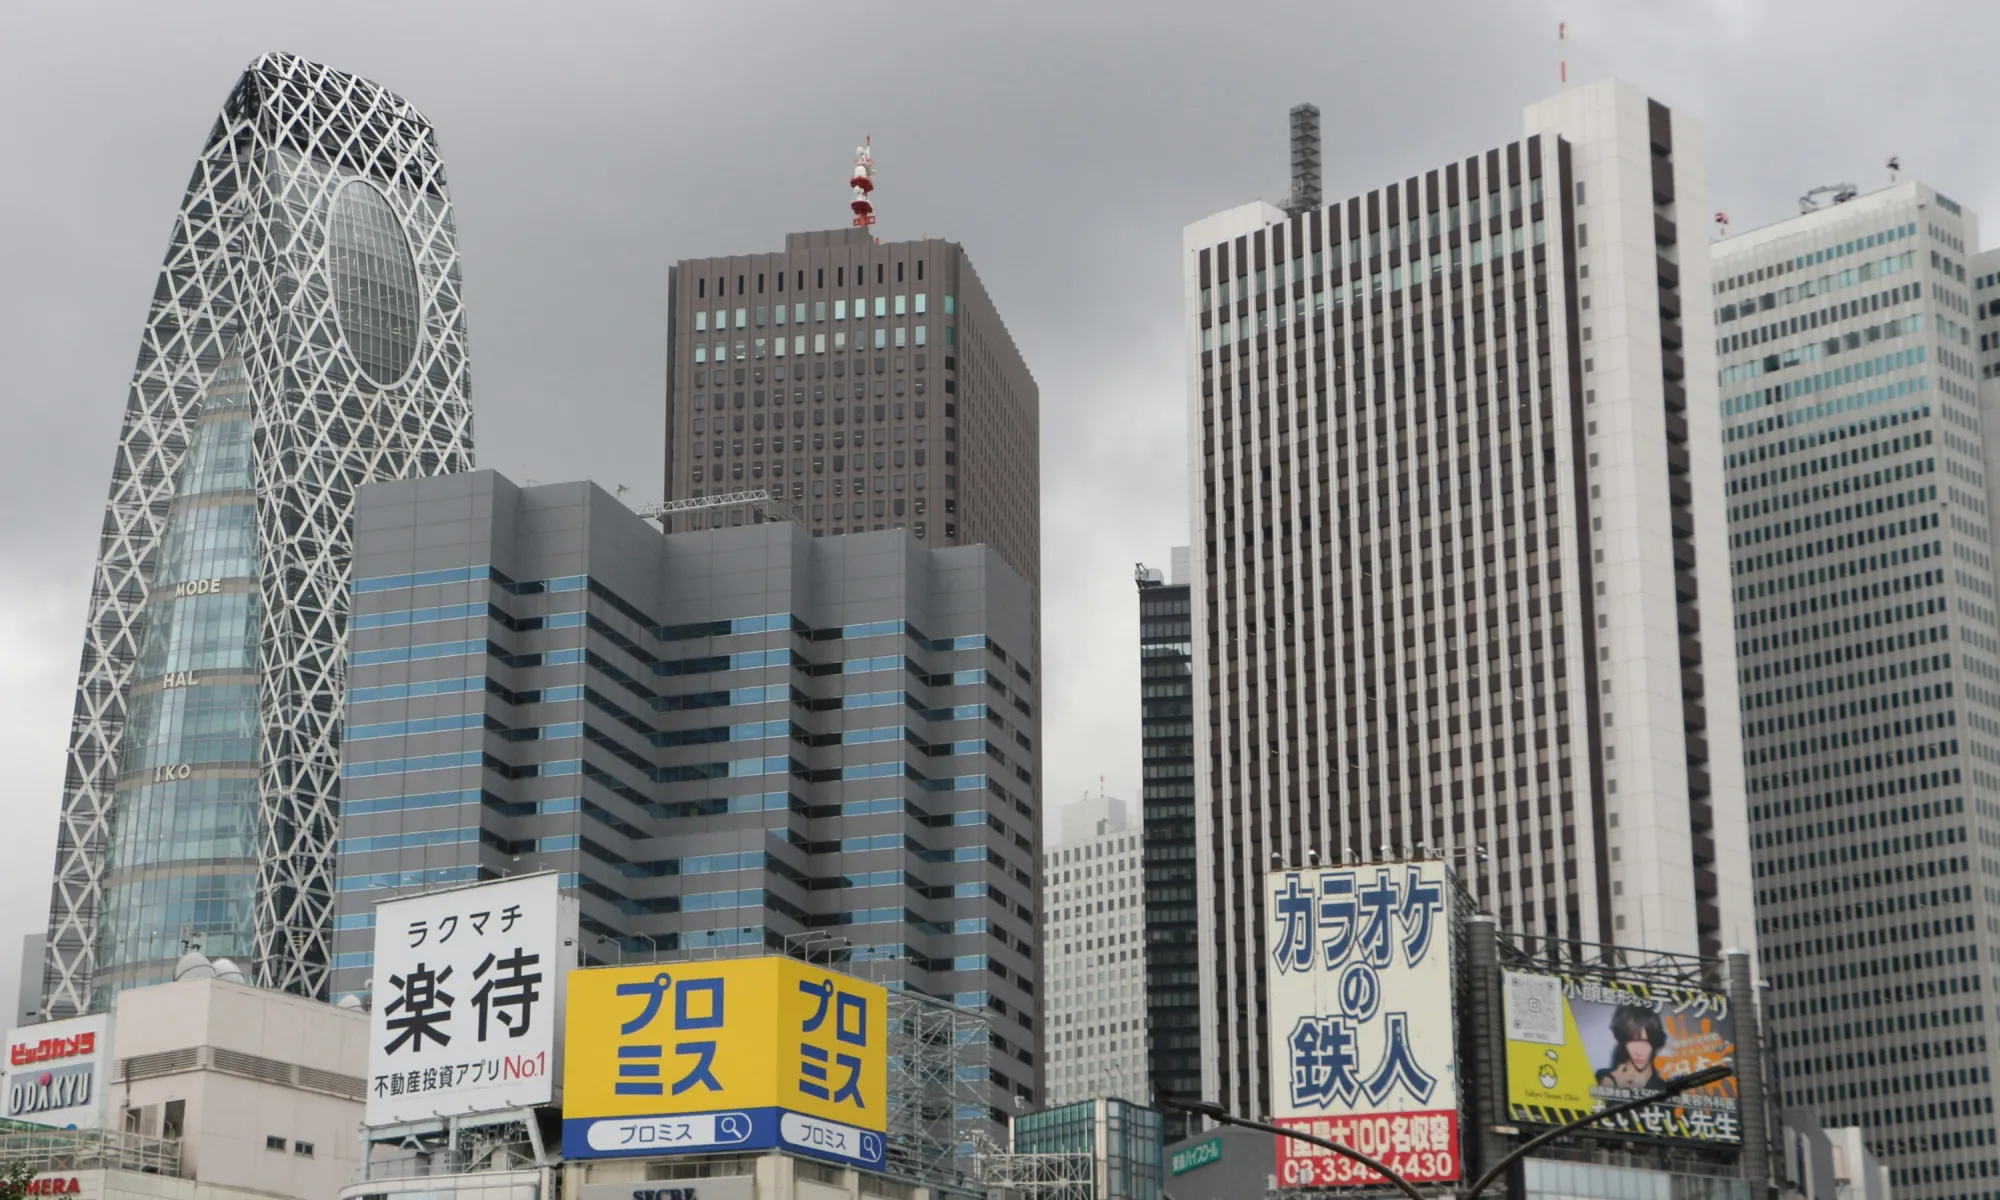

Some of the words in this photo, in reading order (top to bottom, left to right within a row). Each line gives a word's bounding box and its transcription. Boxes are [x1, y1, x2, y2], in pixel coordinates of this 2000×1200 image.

[175, 578, 222, 598] MODE
[163, 671, 199, 689] HAL
[154, 764, 191, 783] IKO
[408, 904, 522, 949] ラクマチ
[1273, 866, 1443, 975] カラオケ
[384, 947, 542, 1056] 楽待
[617, 972, 724, 1035] プロ
[800, 979, 867, 1047] プロ
[1338, 960, 1380, 1023] の
[11, 1031, 95, 1066] ビックカメラ
[615, 1041, 724, 1095] ミス
[1287, 1011, 1437, 1109] 鉄人
[10, 1072, 92, 1115] ODAKYU
[799, 1043, 865, 1108] ミス
[620, 1124, 692, 1145] プロミス
[801, 1124, 846, 1151] プロミス
